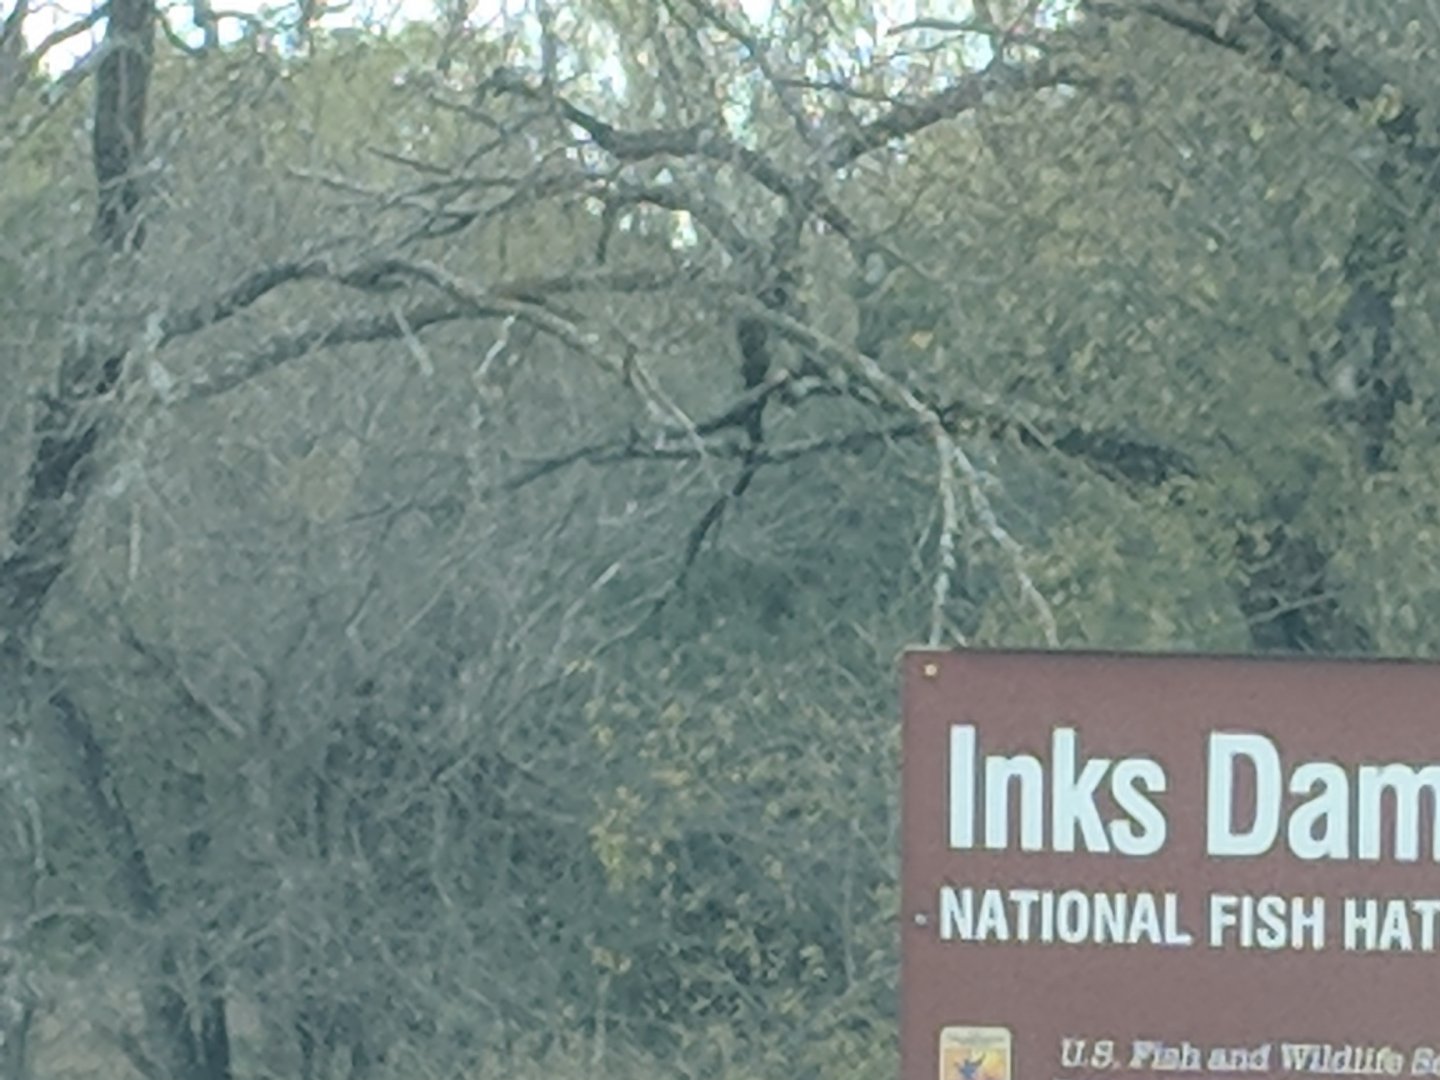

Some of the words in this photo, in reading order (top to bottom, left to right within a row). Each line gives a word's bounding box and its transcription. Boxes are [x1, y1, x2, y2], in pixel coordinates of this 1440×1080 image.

[949, 724, 1168, 858] Inks
[939, 887, 1193, 947] NATIONAL
[1209, 894, 1326, 952] FISH
[1061, 1038, 1122, 1070] U.S.
[1130, 1040, 1203, 1072] Fish
[1206, 1043, 1272, 1072] and
[1281, 1043, 1405, 1077] Wildlife
